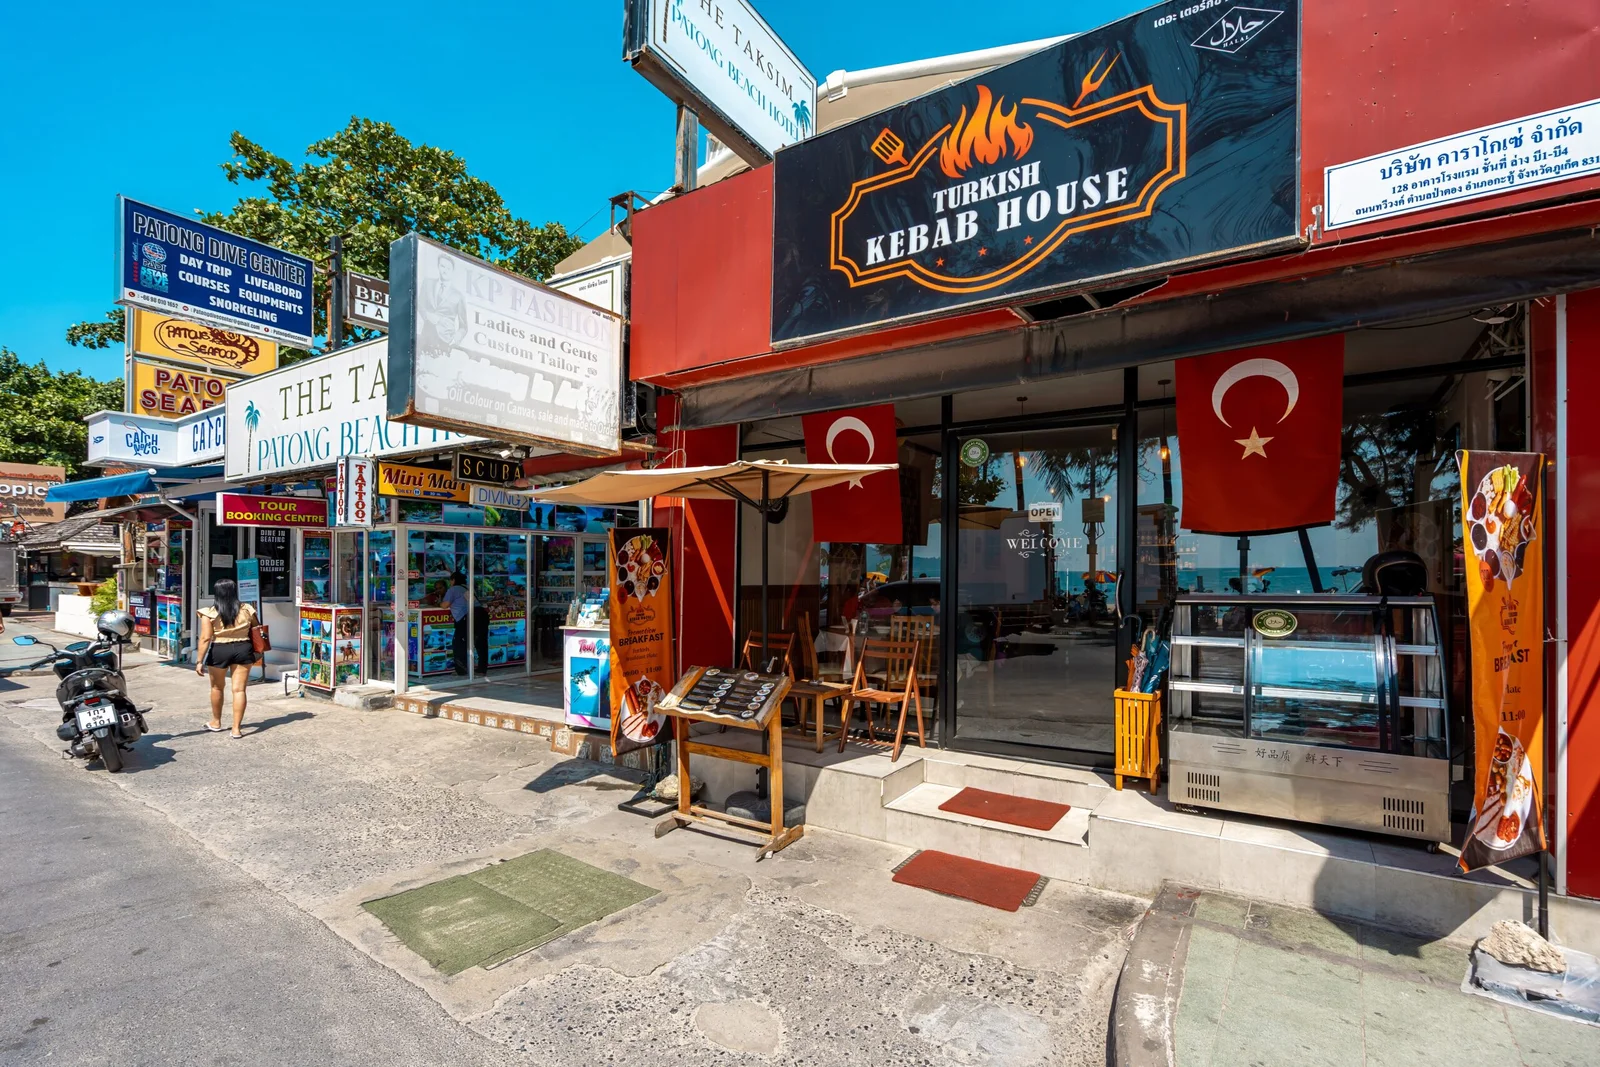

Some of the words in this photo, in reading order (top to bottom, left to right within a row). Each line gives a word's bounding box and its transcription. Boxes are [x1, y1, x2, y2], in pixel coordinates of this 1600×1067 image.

[700, 0, 723, 30] HE
[732, 24, 793, 101] TAKSIM
[1223, 35, 1249, 48] HALAL
[672, 4, 723, 68] PATONG
[728, 61, 765, 110] BEACH
[769, 102, 799, 142] HOTEL
[1380, 153, 1431, 181] บริษัท
[1437, 127, 1523, 166] คาราโกเซ่
[1530, 115, 1584, 144] จำกัด
[932, 160, 1041, 214] TURKISH
[1392, 183, 1409, 195] 128
[1411, 168, 1479, 190] อาคารโรงแรม
[865, 210, 979, 266] KEBAB
[997, 166, 1129, 233] HOUSE
[133, 211, 205, 256] PATONG
[208, 236, 247, 270] DIVE
[249, 251, 306, 288] CENTER
[179, 253, 204, 270] DAY
[206, 263, 232, 278] TRIP
[178, 270, 230, 294] COURSES
[244, 272, 303, 300] LIVEABORD
[464, 269, 503, 306] KP
[209, 295, 278, 323] SNORKELING
[238, 287, 304, 316] EQUIPMENTS
[189, 340, 238, 360] SEAFOOD
[474, 311, 527, 341] Ladies
[529, 331, 557, 350] and
[560, 341, 600, 364] Gents
[473, 333, 535, 362] Custom
[538, 350, 582, 375] Tailor
[155, 369, 230, 397] PATO
[280, 375, 333, 421] THE
[448, 387, 463, 402] Oil
[463, 391, 494, 409] Colour
[494, 402, 506, 411] on
[538, 409, 553, 422] sale
[554, 413, 569, 425] and
[597, 422, 617, 437] Order
[125, 430, 159, 448] CATCH
[258, 426, 330, 471] PATONG
[383, 467, 425, 487] Mini
[462, 458, 521, 480] SCUBA
[0, 482, 48, 497] opic
[354, 463, 367, 519] TATTOO
[479, 486, 521, 506] DIVING
[226, 511, 281, 522] BOOKING
[284, 513, 325, 523] CENTRE
[258, 501, 296, 512] TOUR
[1030, 507, 1060, 517] OPEN
[1006, 537, 1082, 549] WELCOME
[423, 614, 450, 623] TOUR
[619, 632, 665, 647] BREAKFAST
[85, 718, 111, 729] 6101
[1255, 747, 1291, 761] 好品质
[1305, 752, 1343, 768] 鲜天下
